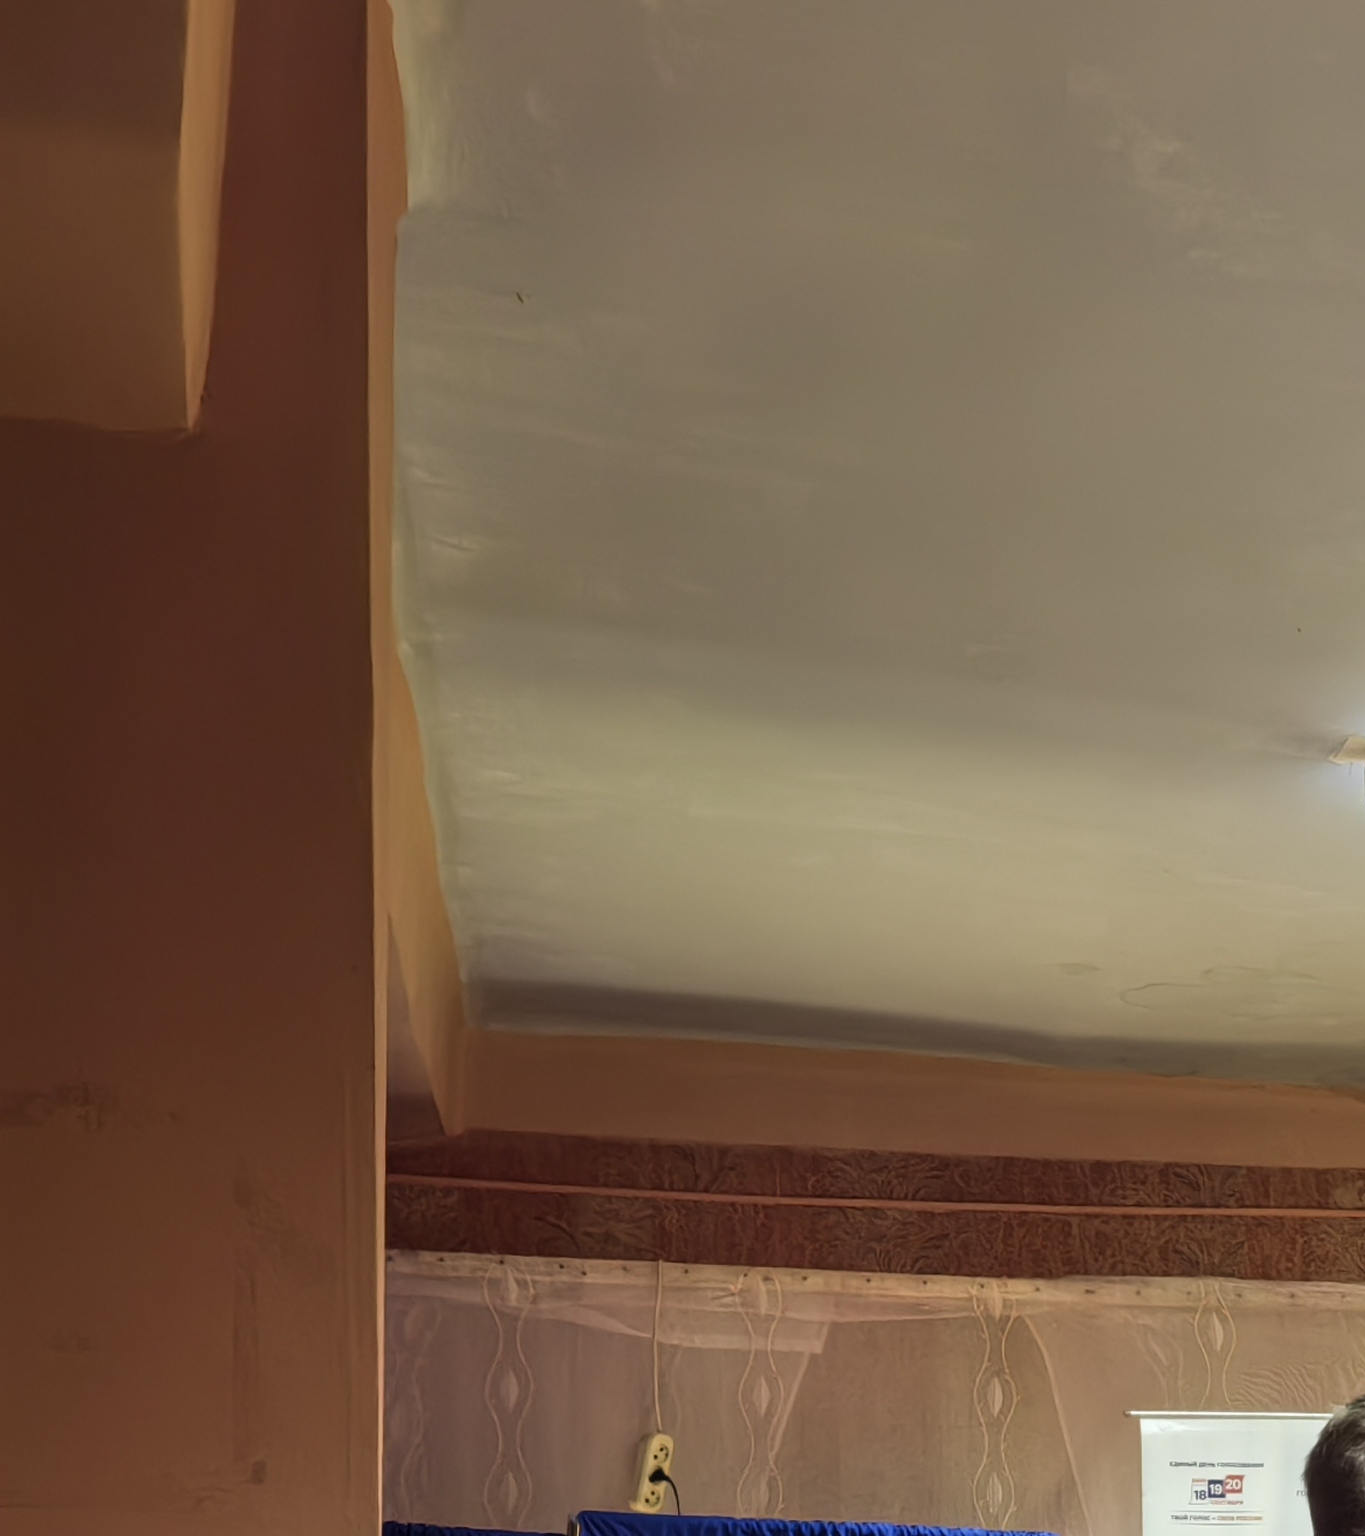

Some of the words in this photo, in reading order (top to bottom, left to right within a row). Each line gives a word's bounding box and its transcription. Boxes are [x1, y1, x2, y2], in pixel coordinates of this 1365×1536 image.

[1194, 1490, 1206, 1500] 18
[1209, 1484, 1222, 1495] 19
[1225, 1479, 1241, 1490] 20
